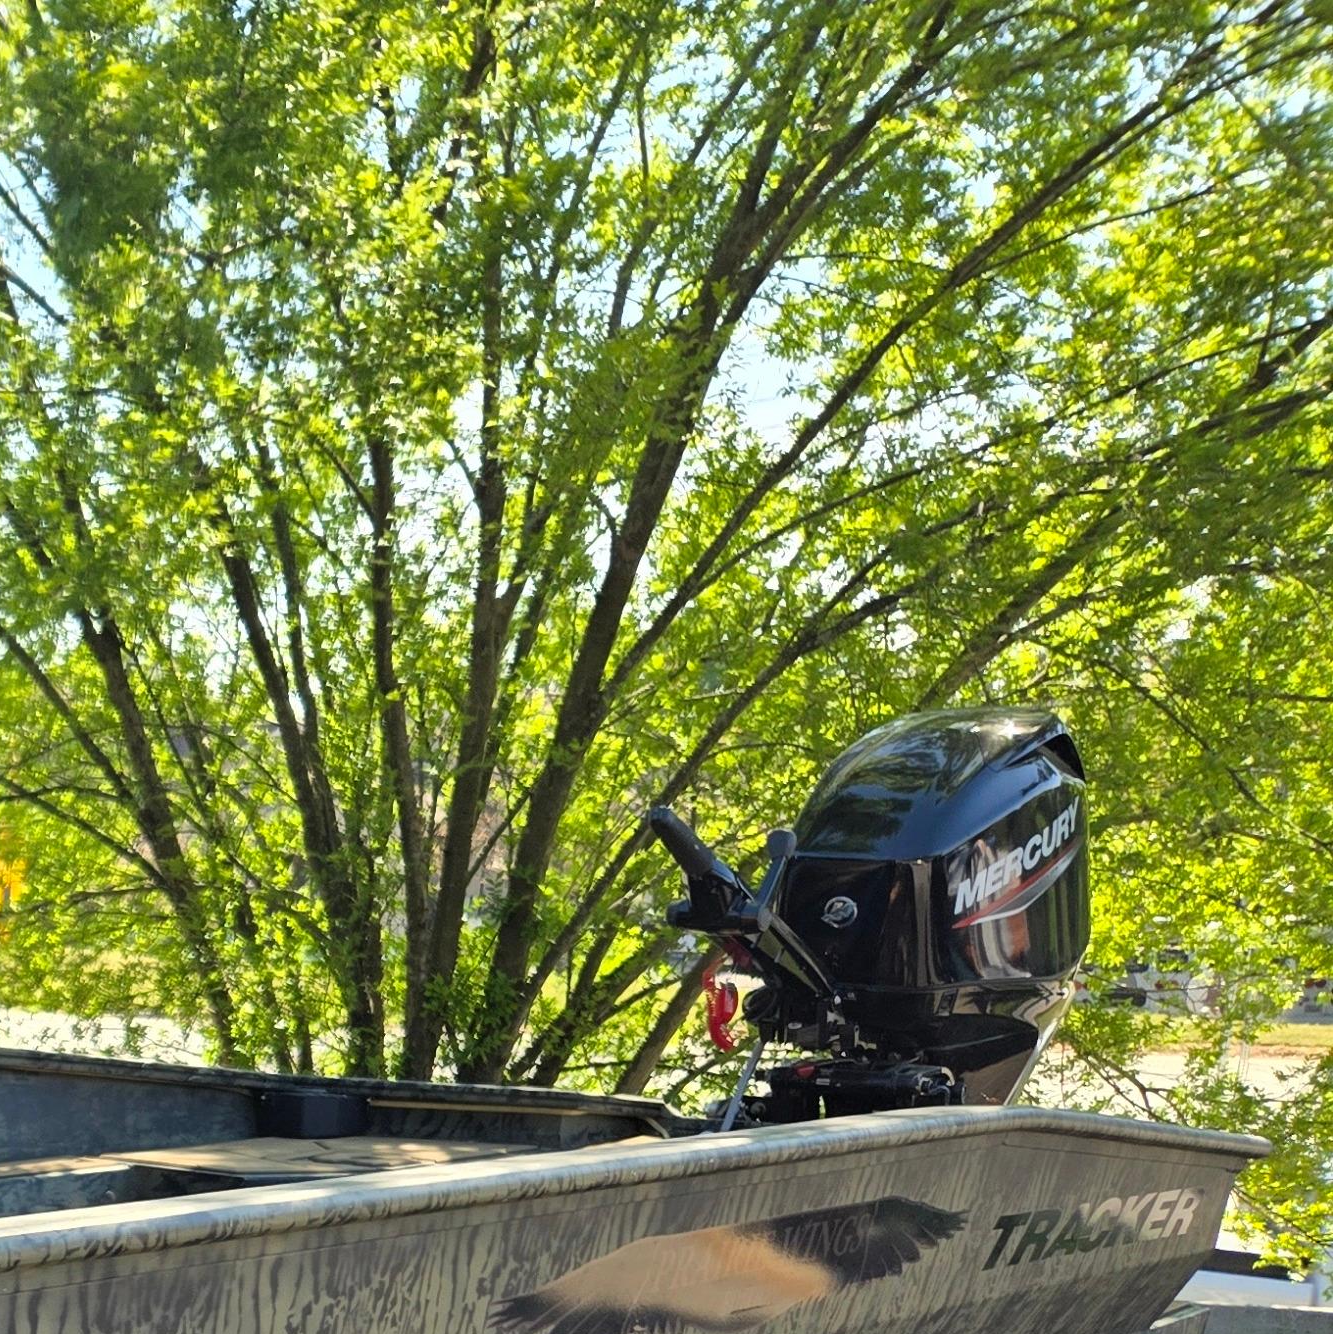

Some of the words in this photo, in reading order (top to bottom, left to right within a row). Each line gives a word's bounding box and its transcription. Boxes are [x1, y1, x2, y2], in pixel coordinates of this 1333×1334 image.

[954, 795, 1080, 915] MERCURY
[783, 1212, 872, 1260] WINGS
[982, 1187, 1206, 1271] TRACKER
